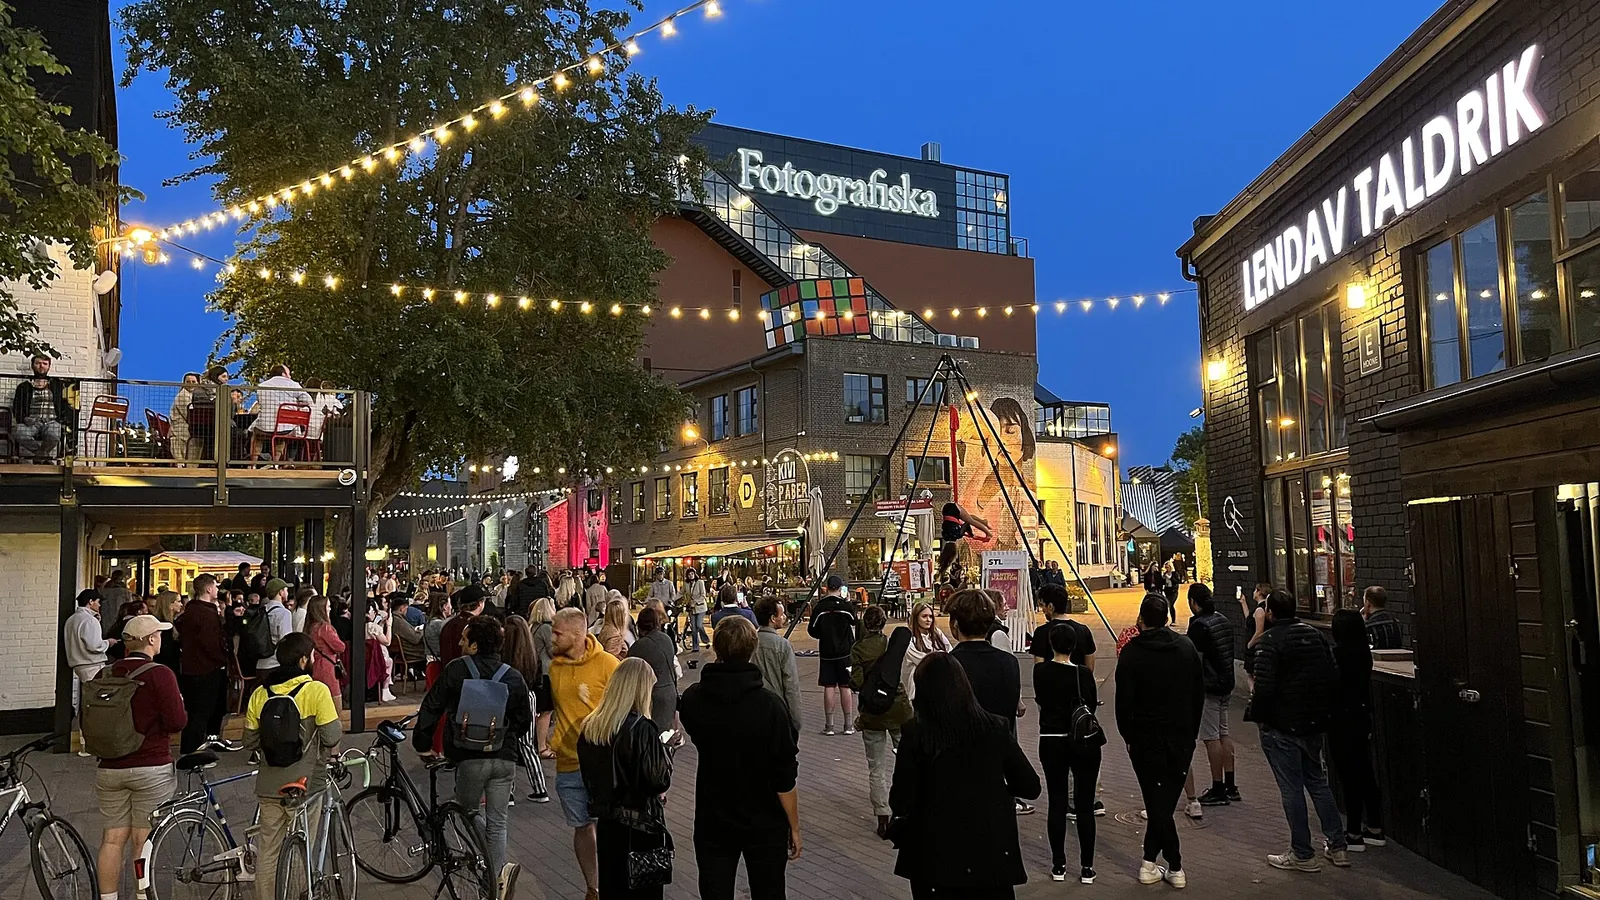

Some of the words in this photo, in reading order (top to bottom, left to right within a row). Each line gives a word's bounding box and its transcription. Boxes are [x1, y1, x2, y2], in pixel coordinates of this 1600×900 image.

[737, 147, 940, 217] Fotografiska
[1242, 185, 1346, 312] LENDAV
[1353, 44, 1544, 237] TALDRIK
[1365, 333, 1374, 356] E
[778, 461, 796, 480] KIVI
[743, 482, 752, 501] D
[779, 482, 808, 501] PABER
[779, 503, 810, 520] KAARID
